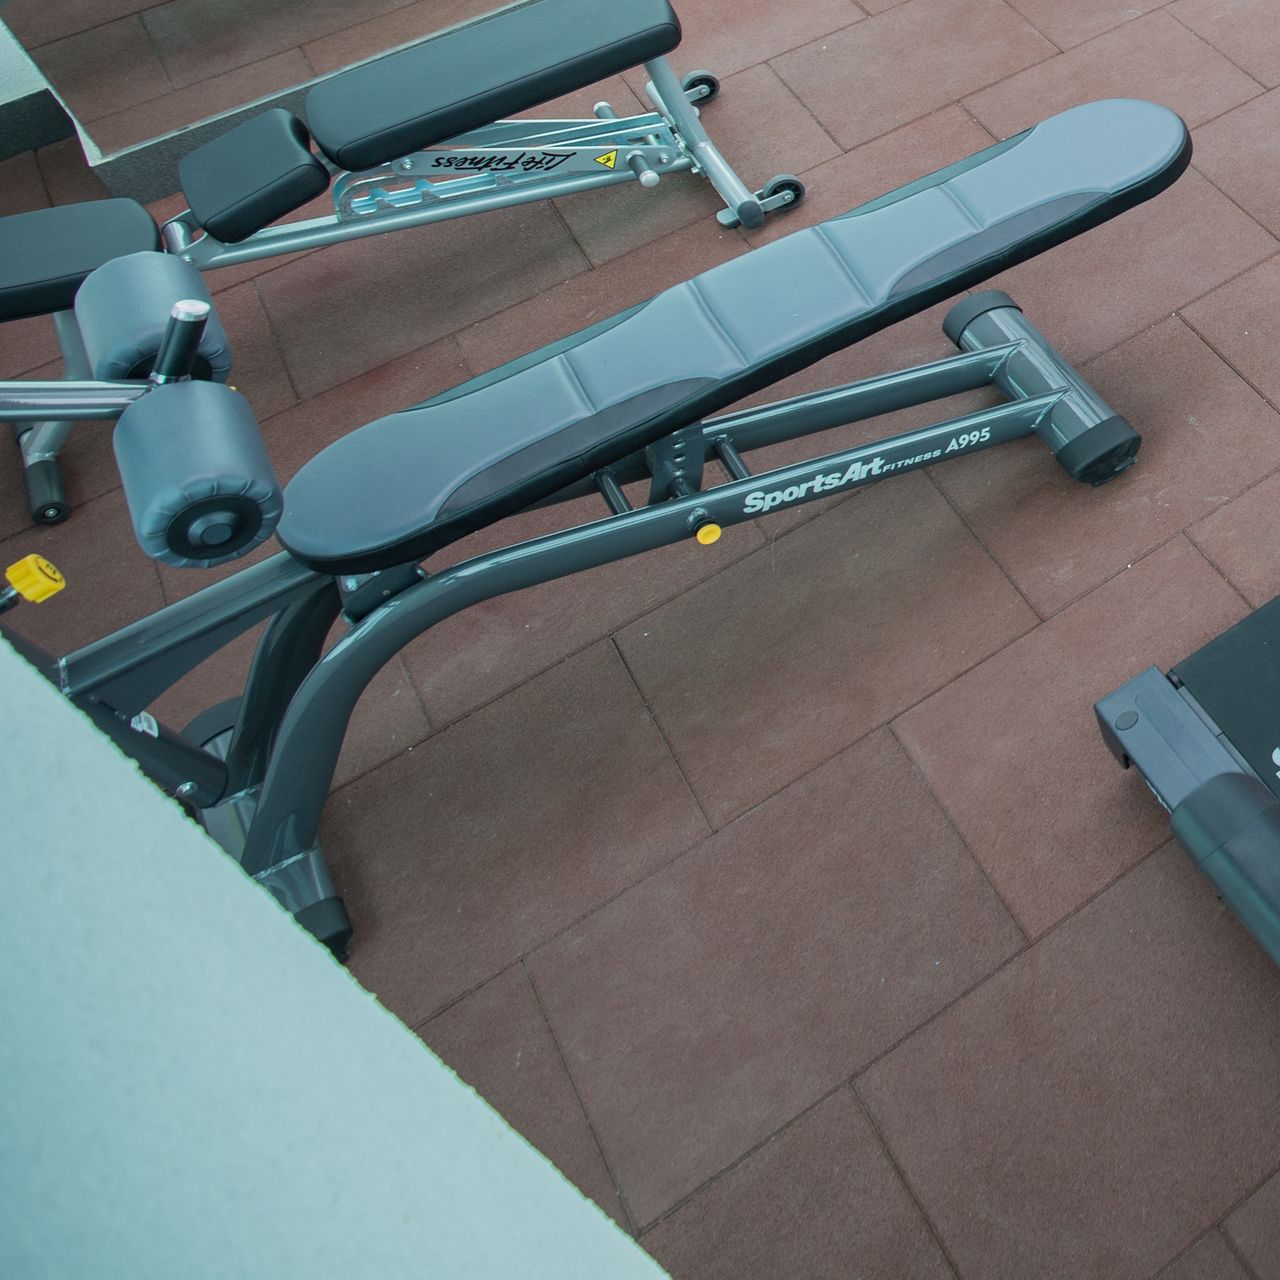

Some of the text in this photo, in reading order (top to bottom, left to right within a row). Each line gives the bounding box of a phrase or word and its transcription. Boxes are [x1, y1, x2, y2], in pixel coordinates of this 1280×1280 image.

[742, 426, 992, 514] SportsArt FITNESS A995
